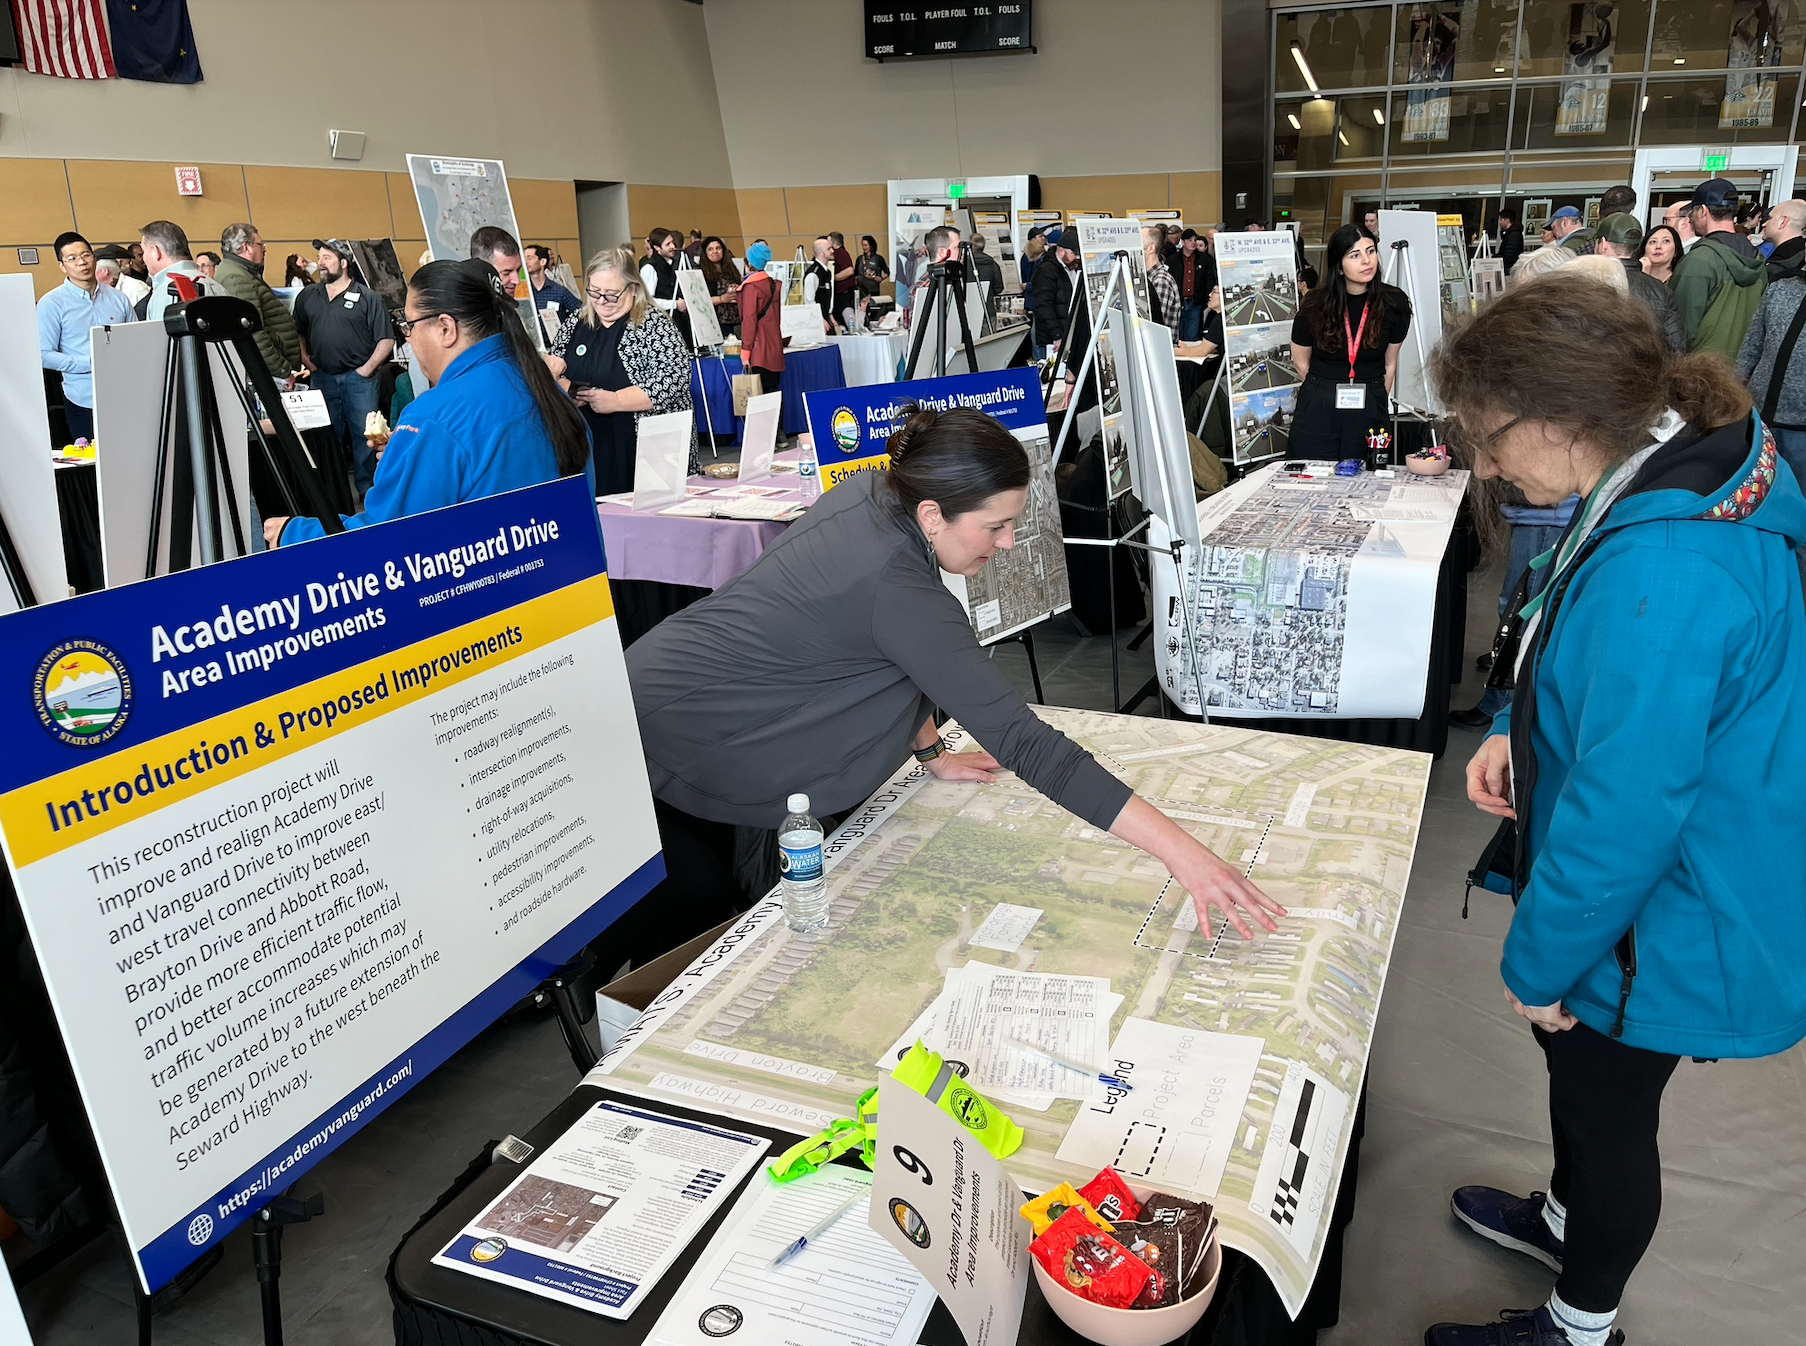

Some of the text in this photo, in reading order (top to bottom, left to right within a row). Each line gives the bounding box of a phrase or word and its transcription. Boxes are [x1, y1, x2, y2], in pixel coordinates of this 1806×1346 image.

[873, 14, 893, 23] FOULS
[900, 13, 917, 21] T.O.L.
[925, 9, 967, 20] PLAYER FOUL
[974, 7, 992, 15] T.O.L.
[999, 5, 1020, 14] FOULS
[874, 45, 894, 54] SCORE
[935, 41, 956, 50] MATCH
[999, 37, 1020, 46] SCORE
[1431, 102, 1449, 117] 33
[1592, 94, 1607, 110] 12
[1753, 86, 1775, 103] 22
[1732, 118, 1759, 127] 1985-89
[289, 394, 303, 403] 51
[919, 396, 947, 413] Drive
[948, 394, 957, 409] &
[957, 387, 1002, 411] Vanguard
[1002, 385, 1025, 402] Drive
[870, 424, 890, 440] Area
[151, 517, 559, 662] Academy Drive & Vanguard Drive
[418, 589, 449, 607] PROJECT
[497, 565, 520, 580] Federal
[162, 606, 386, 698] Area Improvements
[34, 640, 131, 727] TRANSPORTATION & PUBLIC FACILITIES
[429, 653, 574, 725] The project may include the following
[45, 625, 522, 831] Introduction & Proposed Improvements
[59, 711, 129, 746] STATE OF ALASKA
[434, 708, 499, 745] improvements:
[463, 704, 556, 760] roadway realignment(s),
[468, 724, 571, 785] intersection improvements,
[475, 752, 566, 809] drainage improvements,
[87, 758, 339, 883] This reconstruction project will
[481, 773, 573, 834] right-of-way acquisitions,
[97, 775, 373, 915] improve and realign Academy Drive
[486, 811, 554, 858] utility relocations,
[492, 815, 586, 886] pedestrian improvements,
[108, 791, 384, 944] and Vanguard Drive to improve east/
[497, 834, 595, 907] accessibility improvements,
[684, 902, 783, 977] Academy
[873, 790, 903, 803] Dr
[892, 764, 928, 789] Area
[791, 852, 820, 860] ALASKAN
[791, 857, 820, 870] WATER
[116, 831, 370, 973] west travel connectivity between
[503, 865, 586, 931] and roadside hardware.
[971, 904, 1012, 945] Anchorage
[990, 913, 1023, 941] Family
[1008, 915, 1038, 944] Church
[688, 1042, 834, 1084] Brayton Drive
[1142, 1034, 1195, 1120] Project Area
[1288, 1062, 1302, 1082] 400
[653, 1073, 833, 1128] Seward Highway
[1090, 1059, 1135, 1114] Legnd
[1191, 1077, 1226, 1128] Parcels
[217, 1058, 412, 1218] https://academyvanguard.com/
[1269, 1124, 1286, 1147] 200
[893, 1145, 933, 1186] 9
[1309, 1127, 1337, 1218] SCALE IN FEET
[607, 1184, 626, 1192] Contact
[680, 1194, 702, 1203] Schedule
[947, 1136, 965, 1290] Academy Dr & Vanguard Dr
[1250, 1203, 1265, 1214] 0
[965, 1170, 980, 1288] Area Improvements
[534, 1275, 549, 1283] Drive
[547, 1279, 574, 1291] Vanguard
[571, 1280, 611, 1296] Improvements
[589, 1263, 641, 1281] Project Background
[603, 1284, 617, 1292] Sheet
[579, 1289, 595, 1297] Drive
[594, 1292, 621, 1304] Academy
